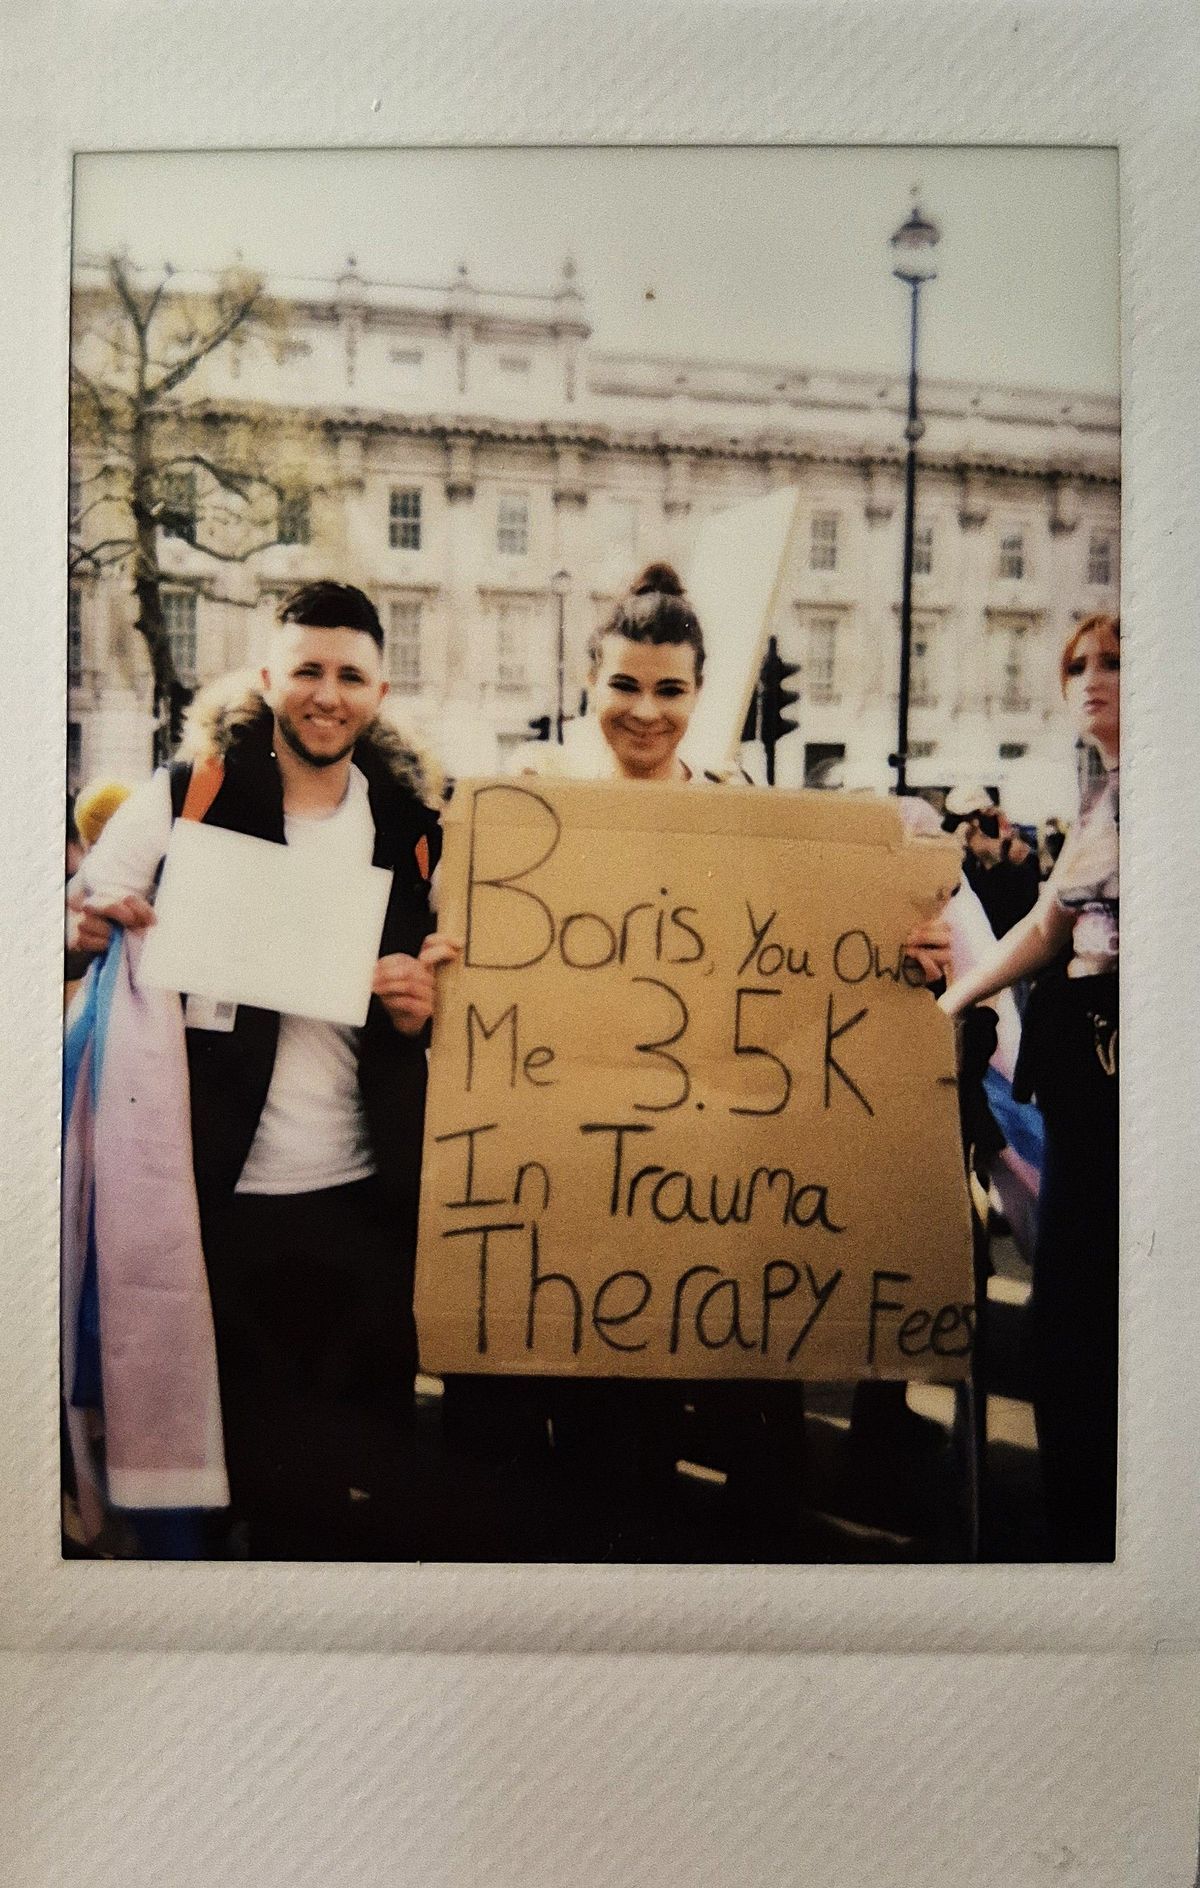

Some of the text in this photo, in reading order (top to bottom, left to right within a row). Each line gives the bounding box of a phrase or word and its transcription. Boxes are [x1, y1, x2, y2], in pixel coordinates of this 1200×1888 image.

[737, 899, 815, 976] You
[466, 1002, 557, 1092] Me
[435, 1123, 846, 1233] In Trauma
